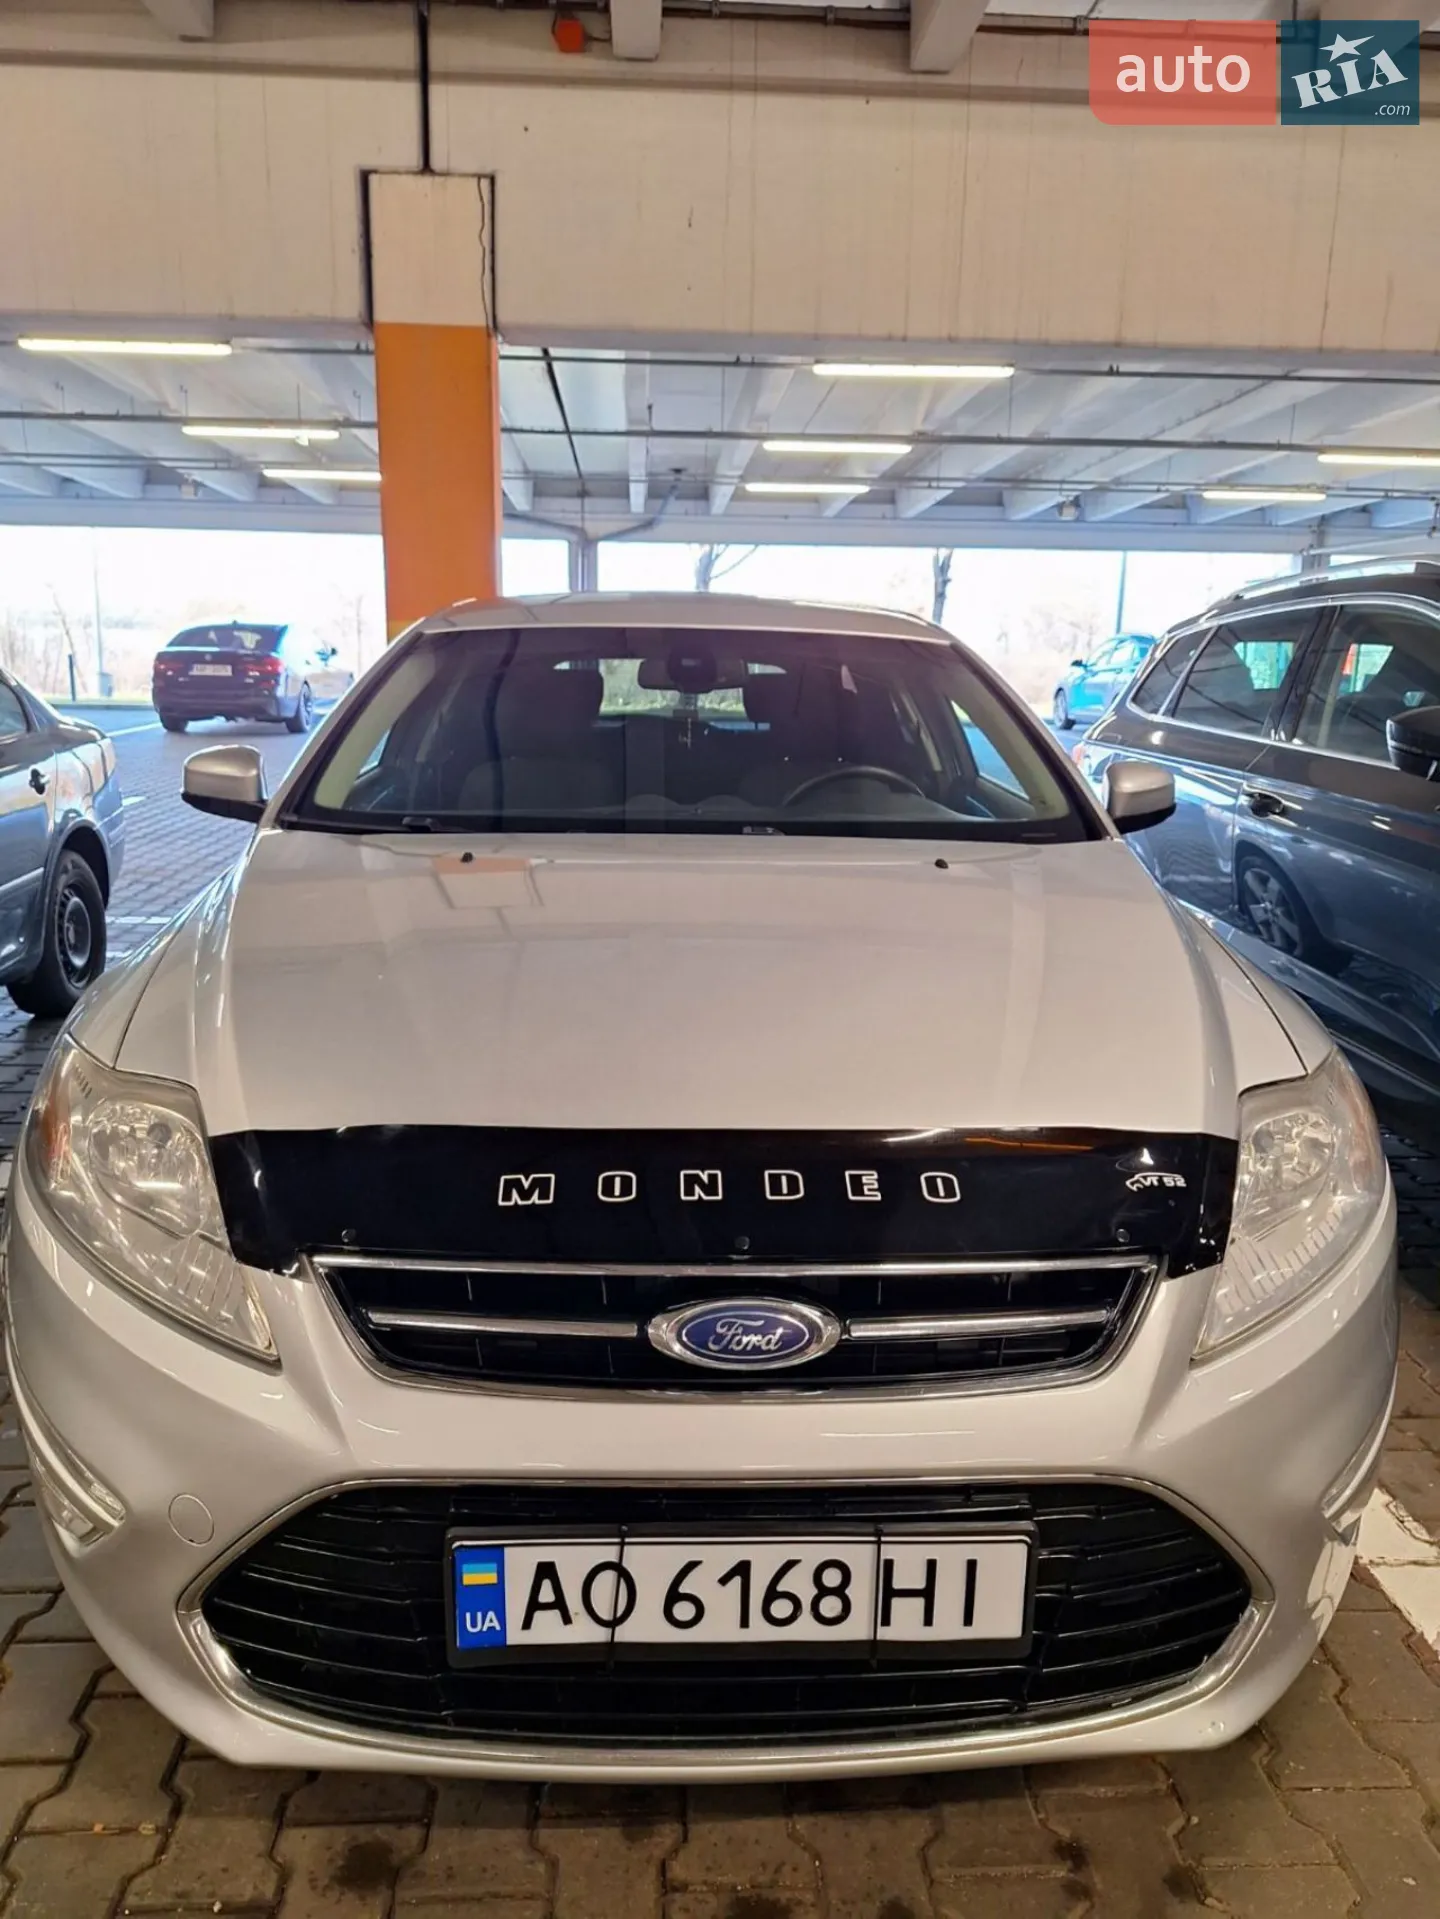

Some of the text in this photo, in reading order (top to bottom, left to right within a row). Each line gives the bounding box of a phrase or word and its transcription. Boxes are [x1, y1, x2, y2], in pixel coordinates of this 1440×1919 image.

[498, 1170, 962, 1206] MONDEO
[708, 1318, 790, 1352] Ford
[521, 1557, 978, 1631] AO 6168 HI
[465, 1611, 502, 1633] UA
